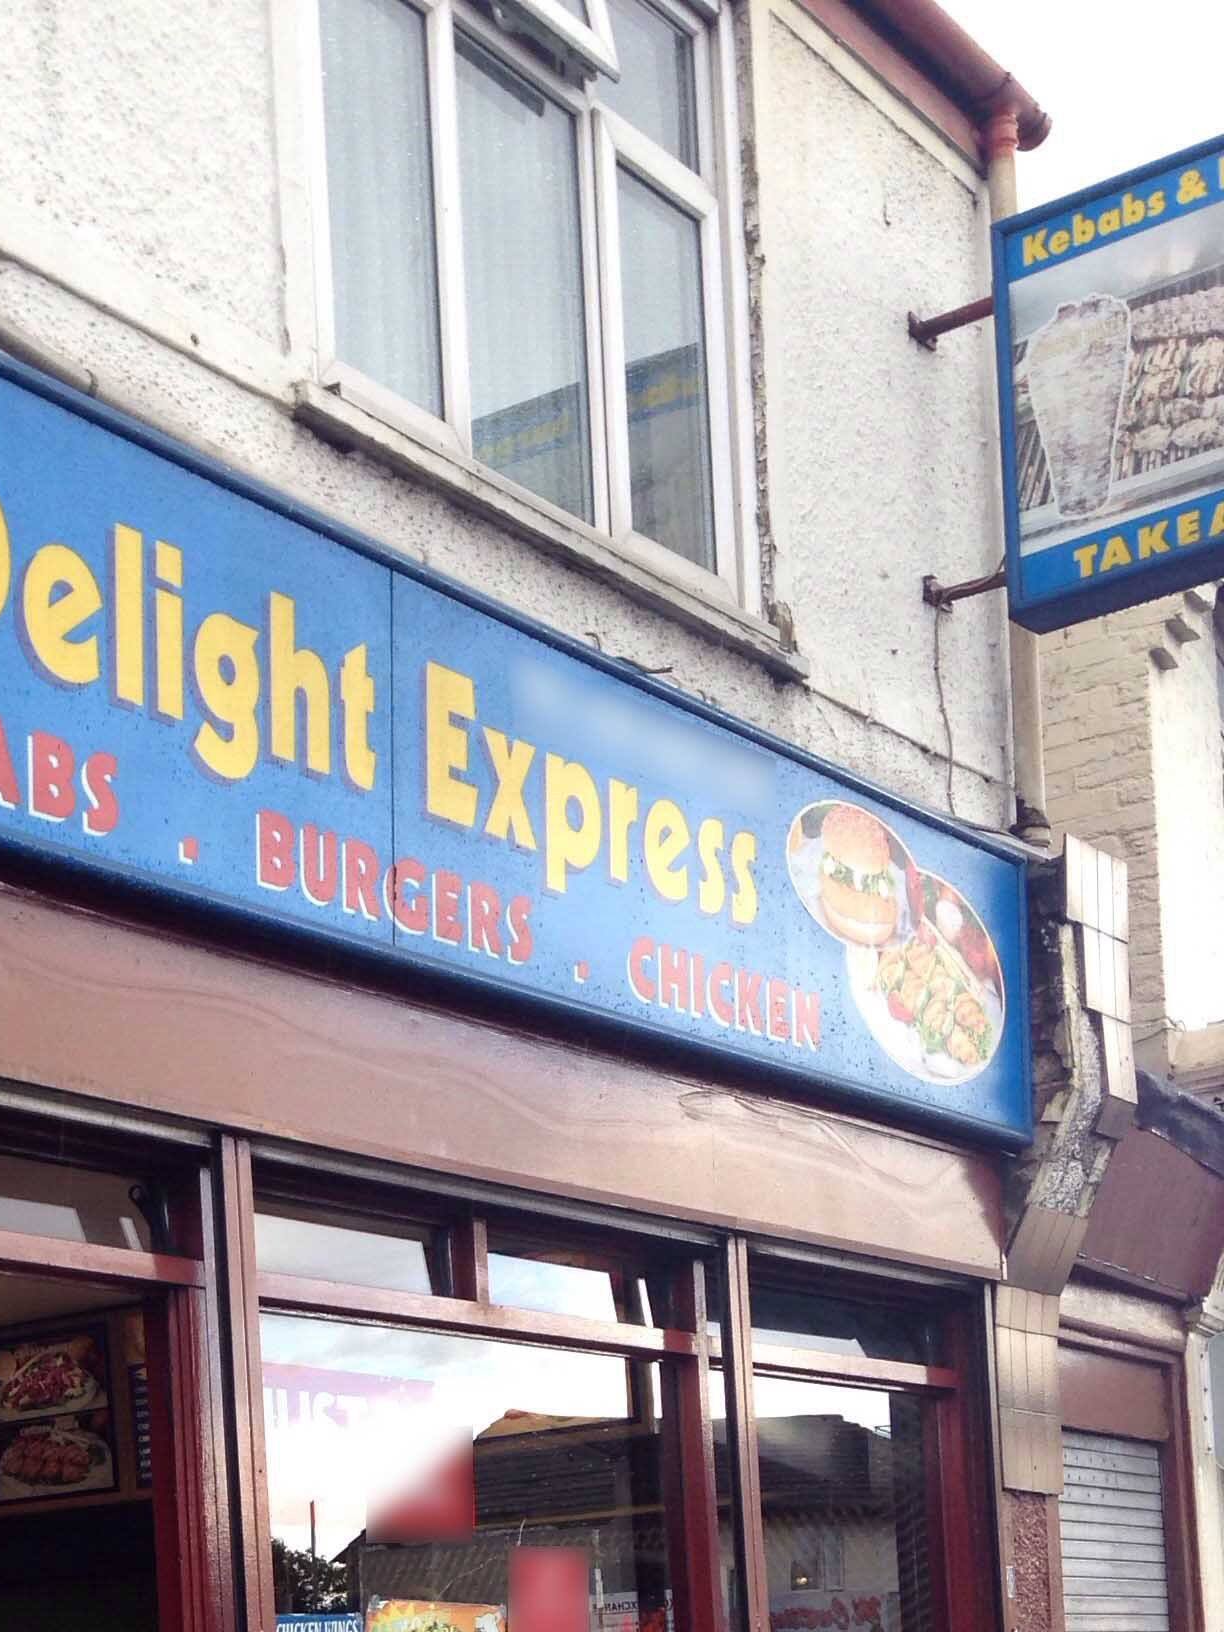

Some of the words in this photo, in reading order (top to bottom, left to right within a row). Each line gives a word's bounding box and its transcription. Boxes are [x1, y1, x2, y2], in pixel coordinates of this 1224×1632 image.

[1022, 190, 1167, 267] Kebabs
[1176, 169, 1208, 205] &
[422, 660, 758, 925] Express
[256, 809, 534, 966] BURGERS
[627, 936, 822, 1052] CHICKEN
